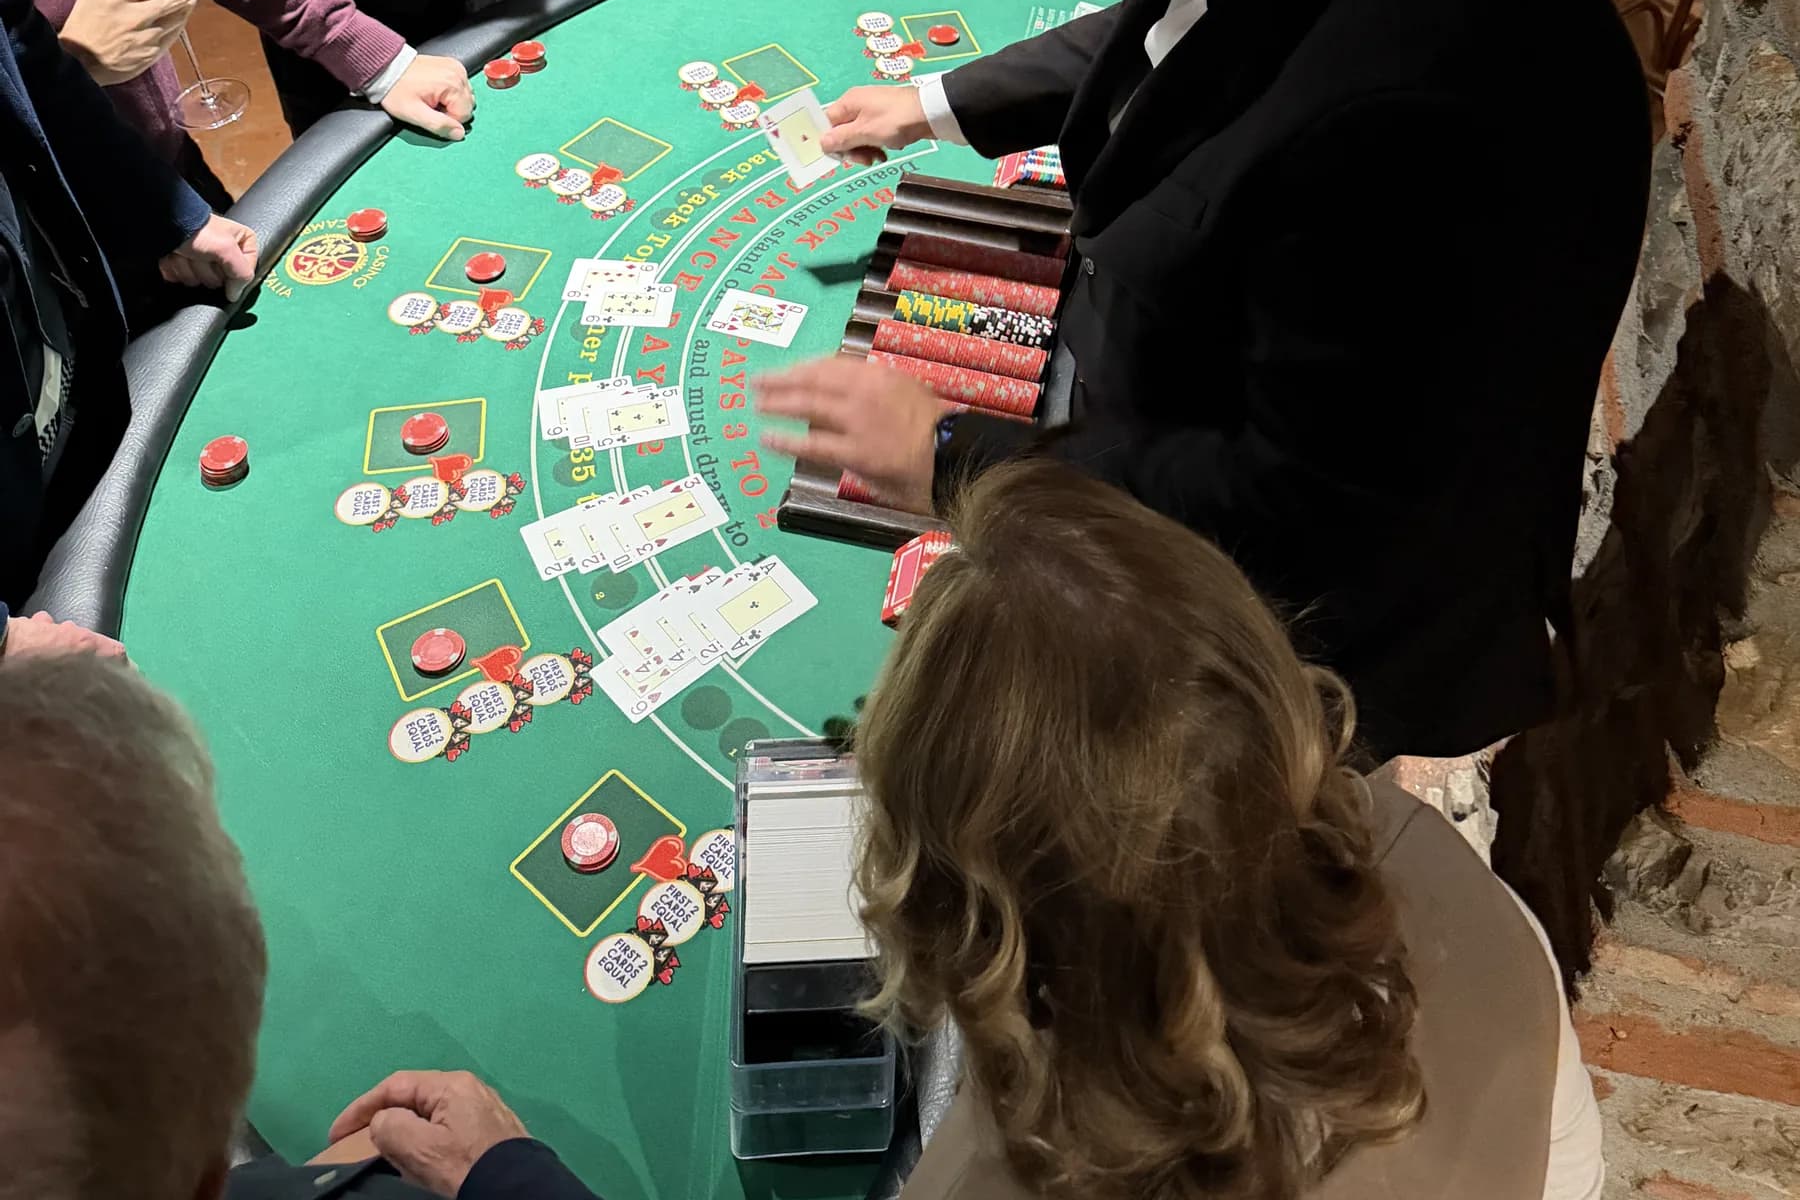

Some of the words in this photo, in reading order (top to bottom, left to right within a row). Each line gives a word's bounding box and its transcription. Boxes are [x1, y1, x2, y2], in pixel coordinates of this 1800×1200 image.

[720, 149, 779, 183] lack
[847, 161, 920, 193] Dealer
[663, 184, 721, 228] Jack
[786, 191, 840, 228] must
[794, 186, 895, 250] BLACK
[735, 227, 785, 275] stand
[353, 246, 389, 289] CASINO
[751, 252, 799, 297] JAC
[689, 339, 710, 379] and
[662, 389, 678, 397] 5
[688, 386, 713, 445] must
[598, 438, 613, 447] 5
[722, 423, 748, 440] 3
[570, 448, 596, 481] 35
[730, 450, 769, 497] TO
[684, 477, 701, 488] 3
[636, 543, 653, 555] 3
[725, 521, 749, 547] to
[545, 563, 563, 575] 2
[582, 555, 600, 568] 2
[613, 554, 632, 569] 10
[760, 561, 777, 575] A
[700, 644, 719, 659] 2
[731, 636, 749, 652] A
[529, 666, 550, 697] EQUAL
[539, 663, 559, 692] CARDS
[548, 658, 563, 680] FIRST
[561, 680, 568, 688] 2
[468, 693, 488, 724] EQUAL
[479, 690, 498, 719] CARDS
[488, 685, 503, 707] FIRST
[500, 707, 507, 715] 2
[405, 721, 425, 752] EQUAL
[416, 719, 435, 748] CARDS
[426, 712, 440, 734] FIRST
[438, 735, 444, 744] 2
[714, 834, 735, 855] FIRS
[700, 850, 731, 879] EQUAL
[659, 894, 692, 923] CARDS
[665, 884, 692, 907] FIRST
[692, 905, 700, 915] 2
[650, 901, 681, 933] EQUAL
[607, 948, 640, 979] CARDS
[614, 938, 641, 963] FIRST
[640, 960, 648, 970] 2
[597, 956, 629, 989] EQUAL
